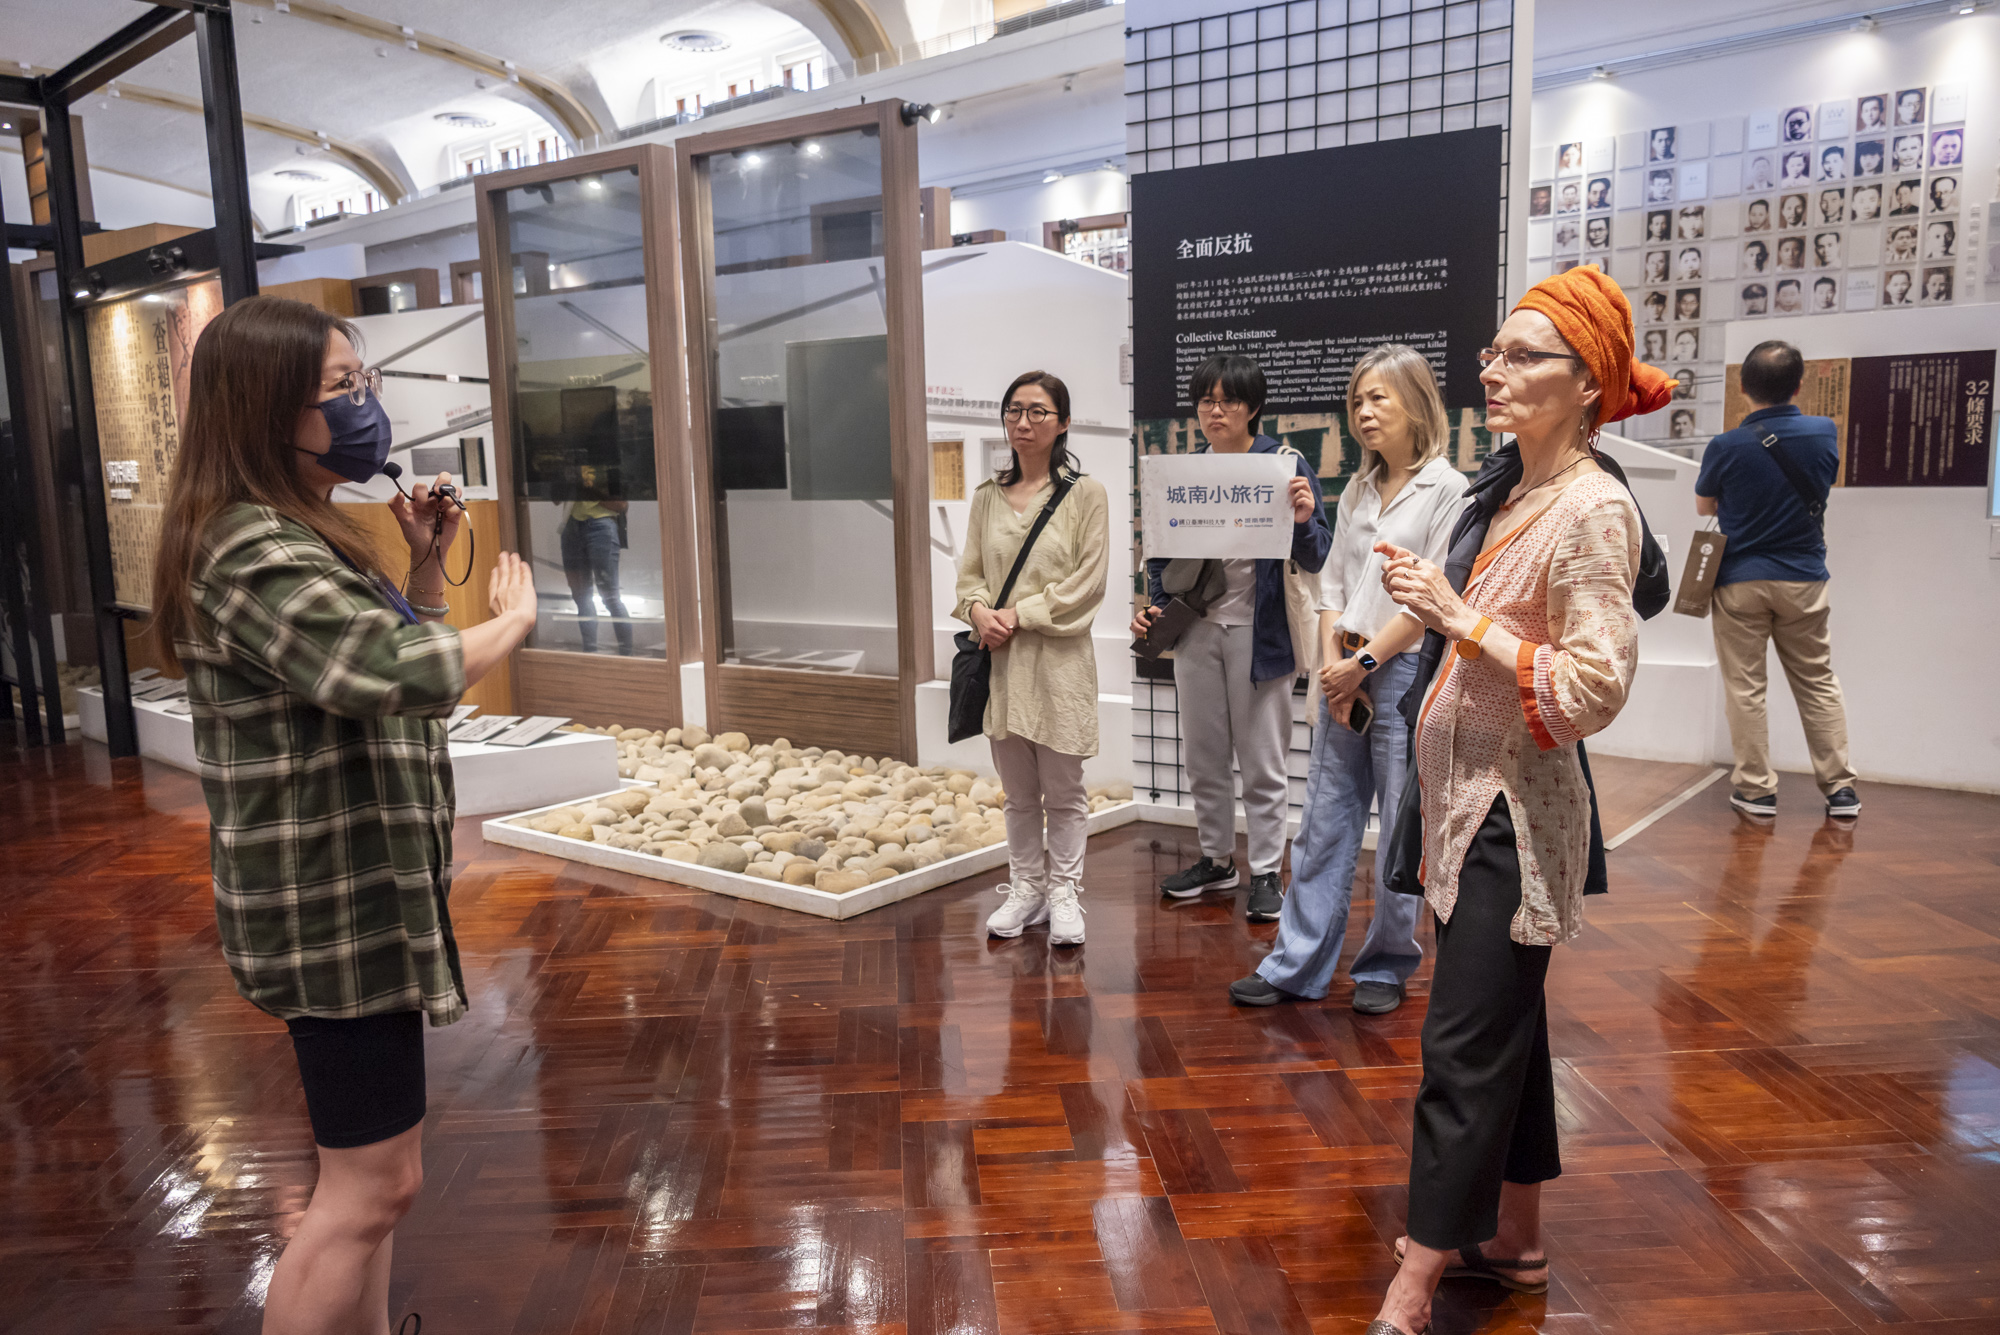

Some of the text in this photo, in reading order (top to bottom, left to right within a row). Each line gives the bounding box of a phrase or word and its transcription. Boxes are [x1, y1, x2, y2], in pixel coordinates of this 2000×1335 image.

[1176, 233, 1253, 260] 全面反抗
[1176, 329, 1277, 343] Collective Resistance
[1176, 347, 1206, 355] Beginning
[1266, 341, 1286, 350] people
[1288, 339, 1322, 348] throughout
[1359, 334, 1393, 344] responded
[1405, 332, 1436, 340] February
[1272, 350, 1295, 359] fighting
[1297, 348, 1323, 357] together.
[1428, 340, 1447, 348] killed
[1265, 396, 1289, 405] political
[1166, 485, 1274, 504] 城南小旅行
